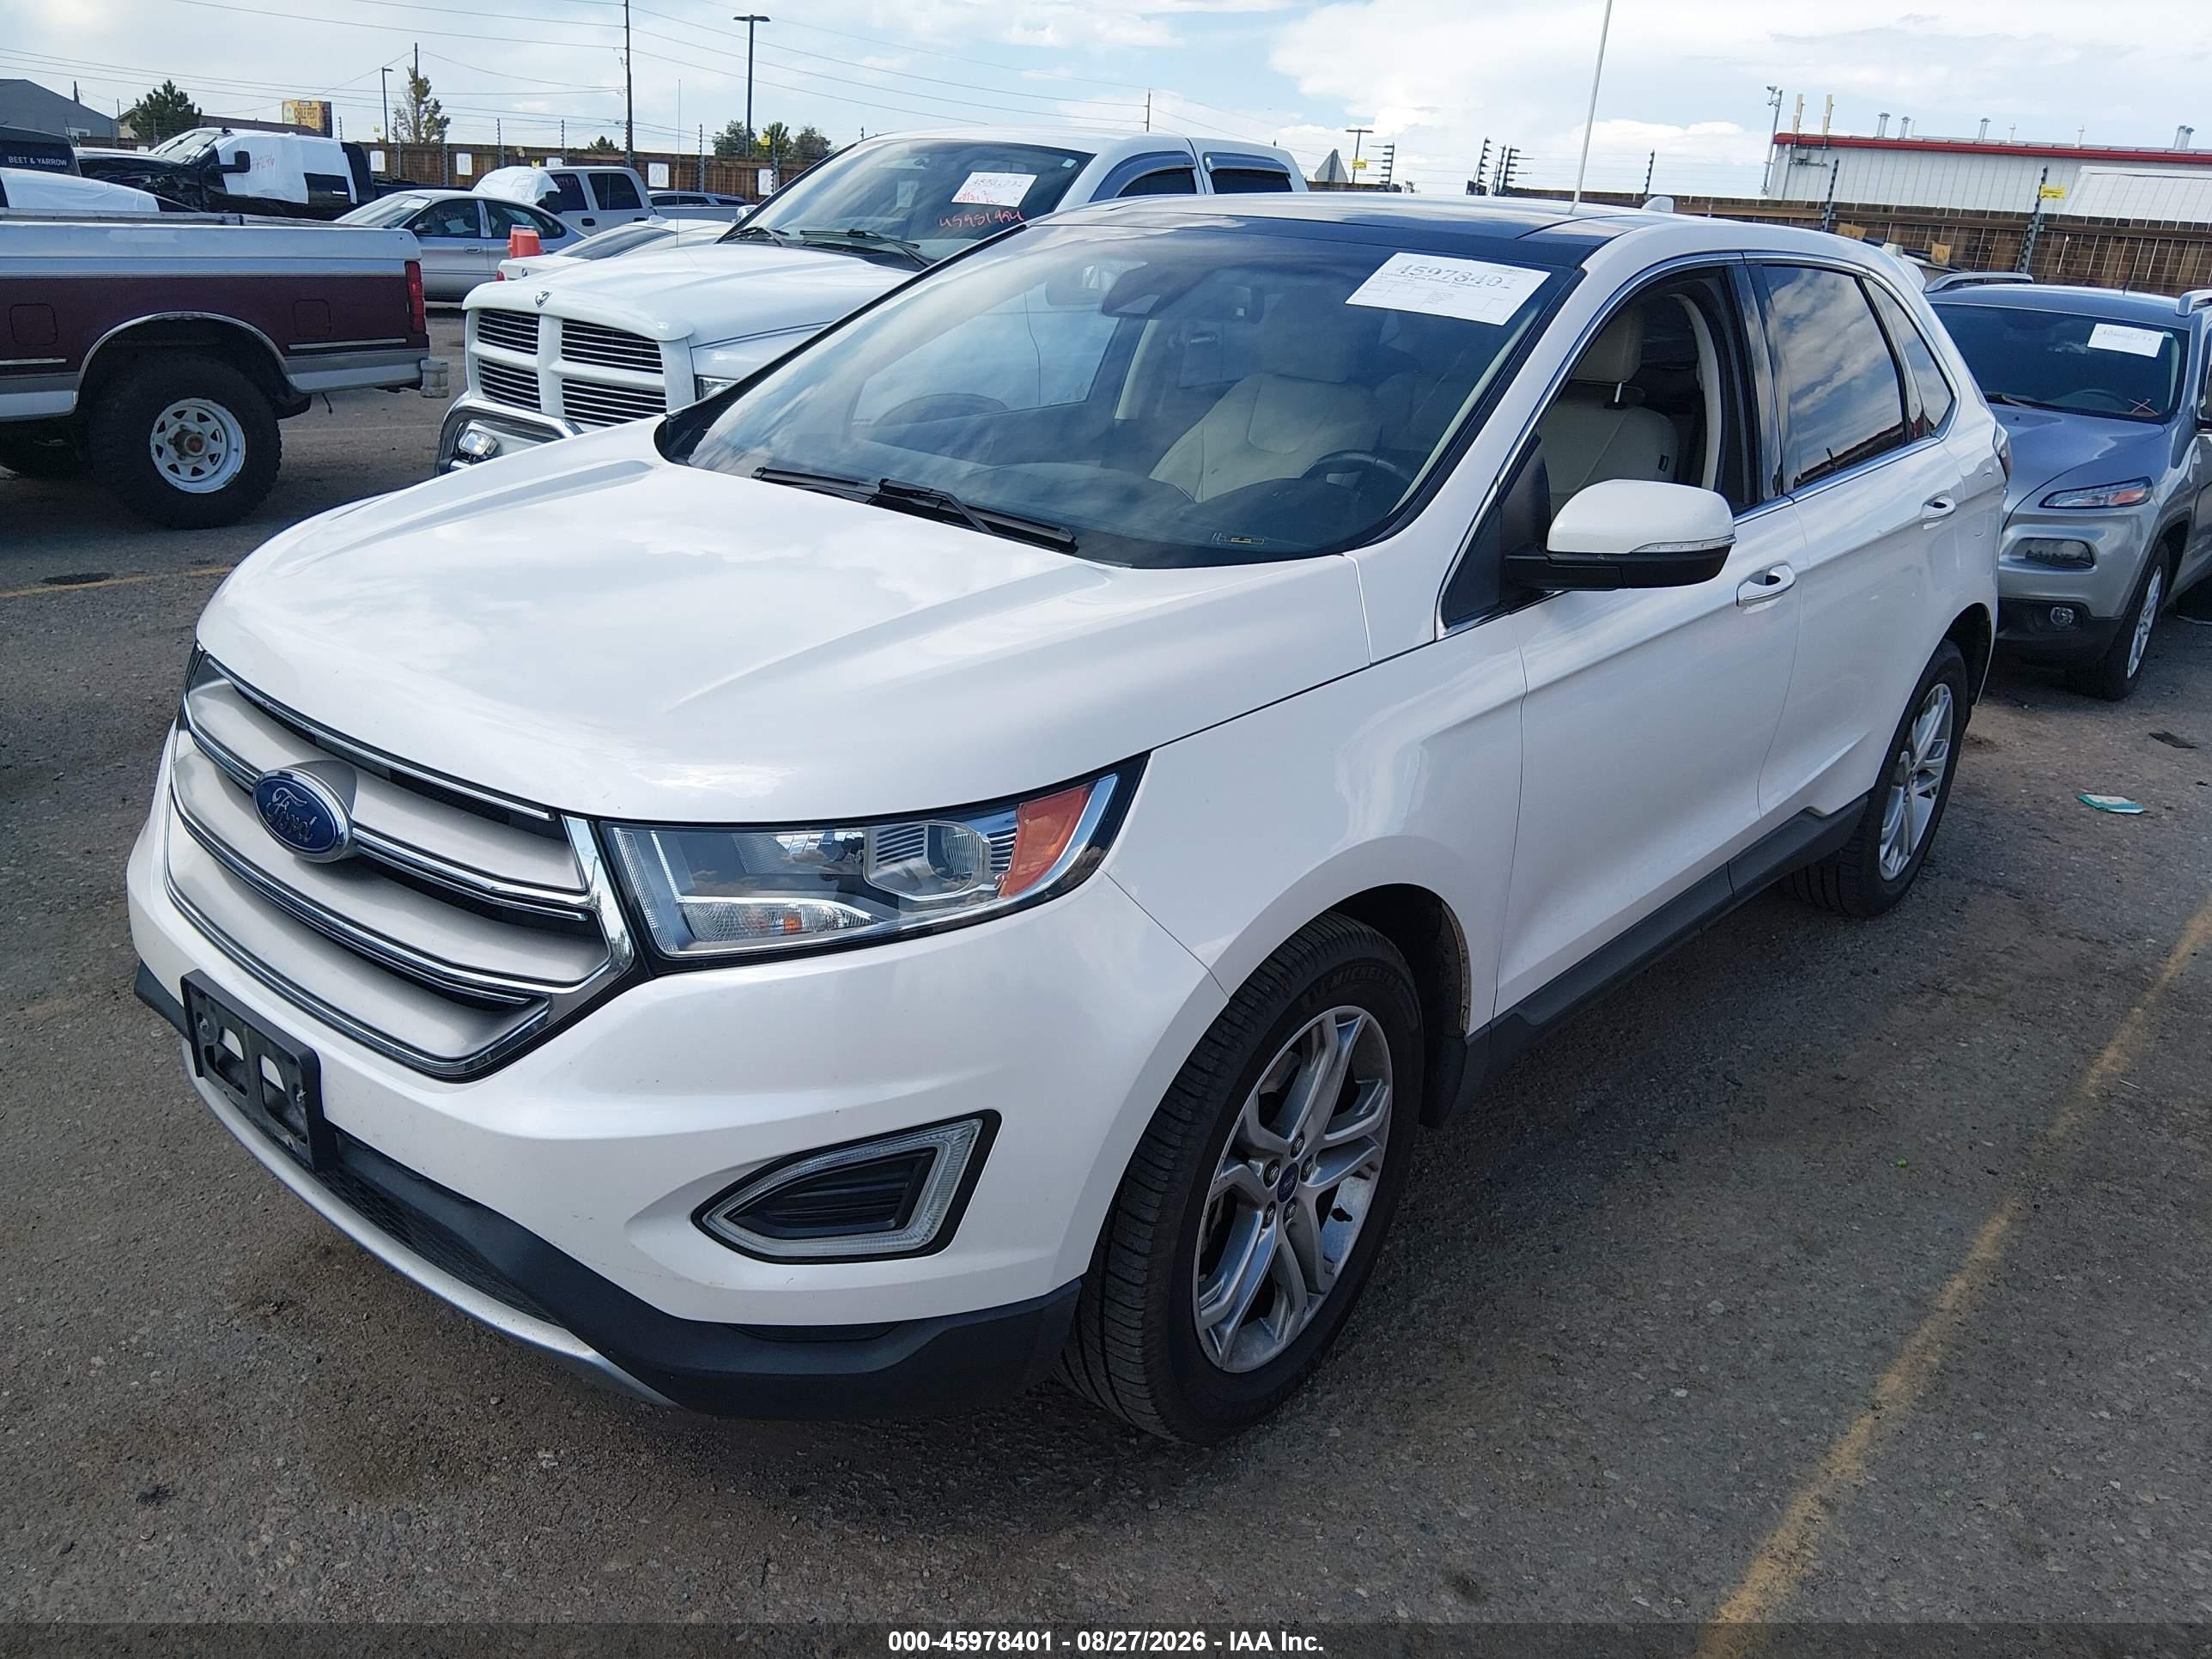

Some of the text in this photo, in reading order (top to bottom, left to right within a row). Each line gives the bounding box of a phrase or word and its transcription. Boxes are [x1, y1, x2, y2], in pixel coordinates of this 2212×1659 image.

[8, 155, 27, 165] BEET
[36, 158, 67, 167] YARROW
[651, 166, 666, 183] 20
[265, 787, 318, 843] Ford
[1331, 966, 1403, 990] MICHELIN
